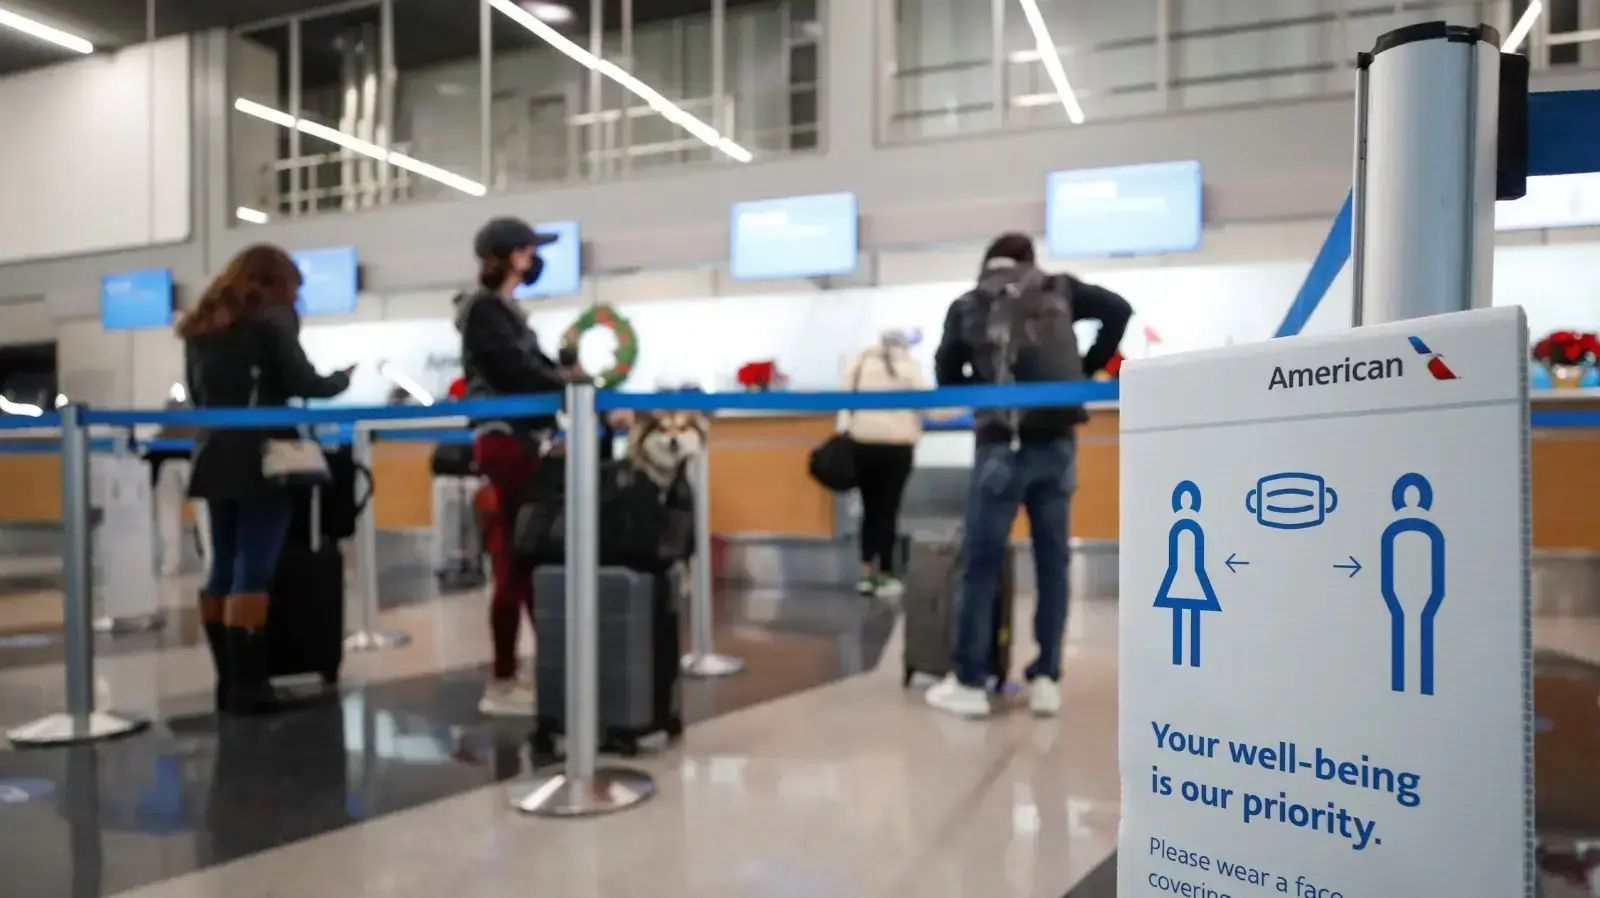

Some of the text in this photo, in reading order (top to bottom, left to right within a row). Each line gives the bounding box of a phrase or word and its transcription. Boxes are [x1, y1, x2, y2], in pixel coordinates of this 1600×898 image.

[1268, 356, 1403, 390] American
[1151, 721, 1420, 807] Your well-being
[1152, 765, 1381, 850] is our priority.
[1150, 837, 1210, 871] Please
[1217, 859, 1269, 887] wear
[1276, 876, 1288, 893] a
